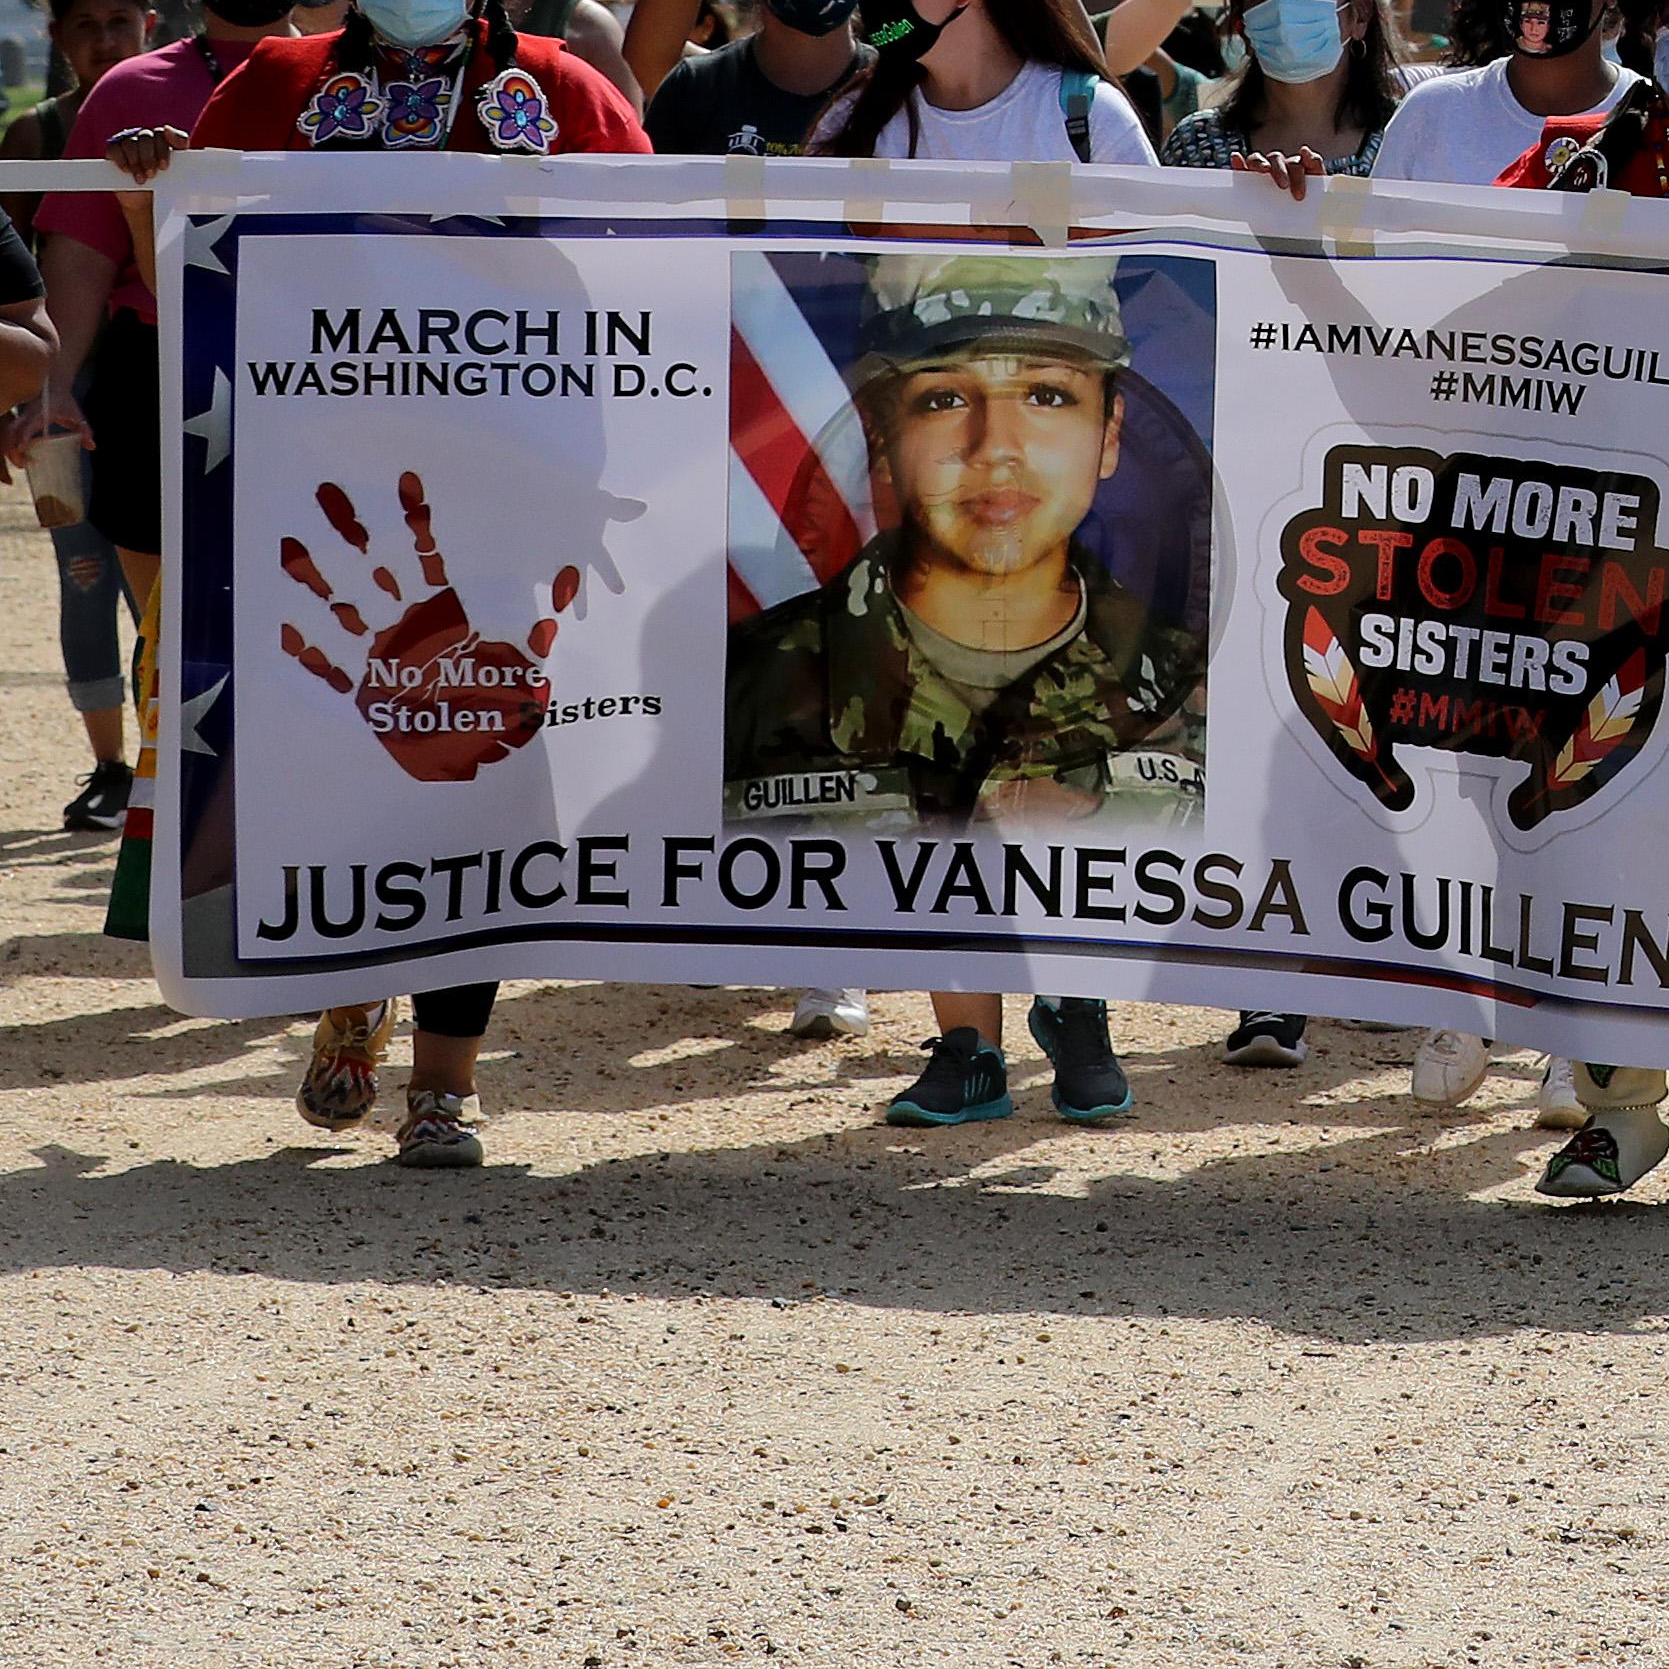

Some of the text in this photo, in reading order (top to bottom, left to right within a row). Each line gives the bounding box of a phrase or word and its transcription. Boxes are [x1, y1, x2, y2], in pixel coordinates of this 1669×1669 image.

[311, 309, 652, 355] MARCH IN
[249, 362, 712, 397] WASHINGTON D.C.
[1430, 370, 1587, 415] #MMIW
[1342, 462, 1641, 551] NO MORE
[1296, 526, 1666, 636] STOLEN
[369, 657, 547, 689] No More
[1359, 613, 1590, 695] SISTERS
[367, 694, 662, 732] Stolen Sisters
[1390, 688, 1547, 742] #MMIW
[745, 772, 855, 810] GUILLEN
[255, 833, 630, 942] JUSTICE
[661, 835, 848, 911] FOR
[875, 840, 1310, 935] VANESSA
